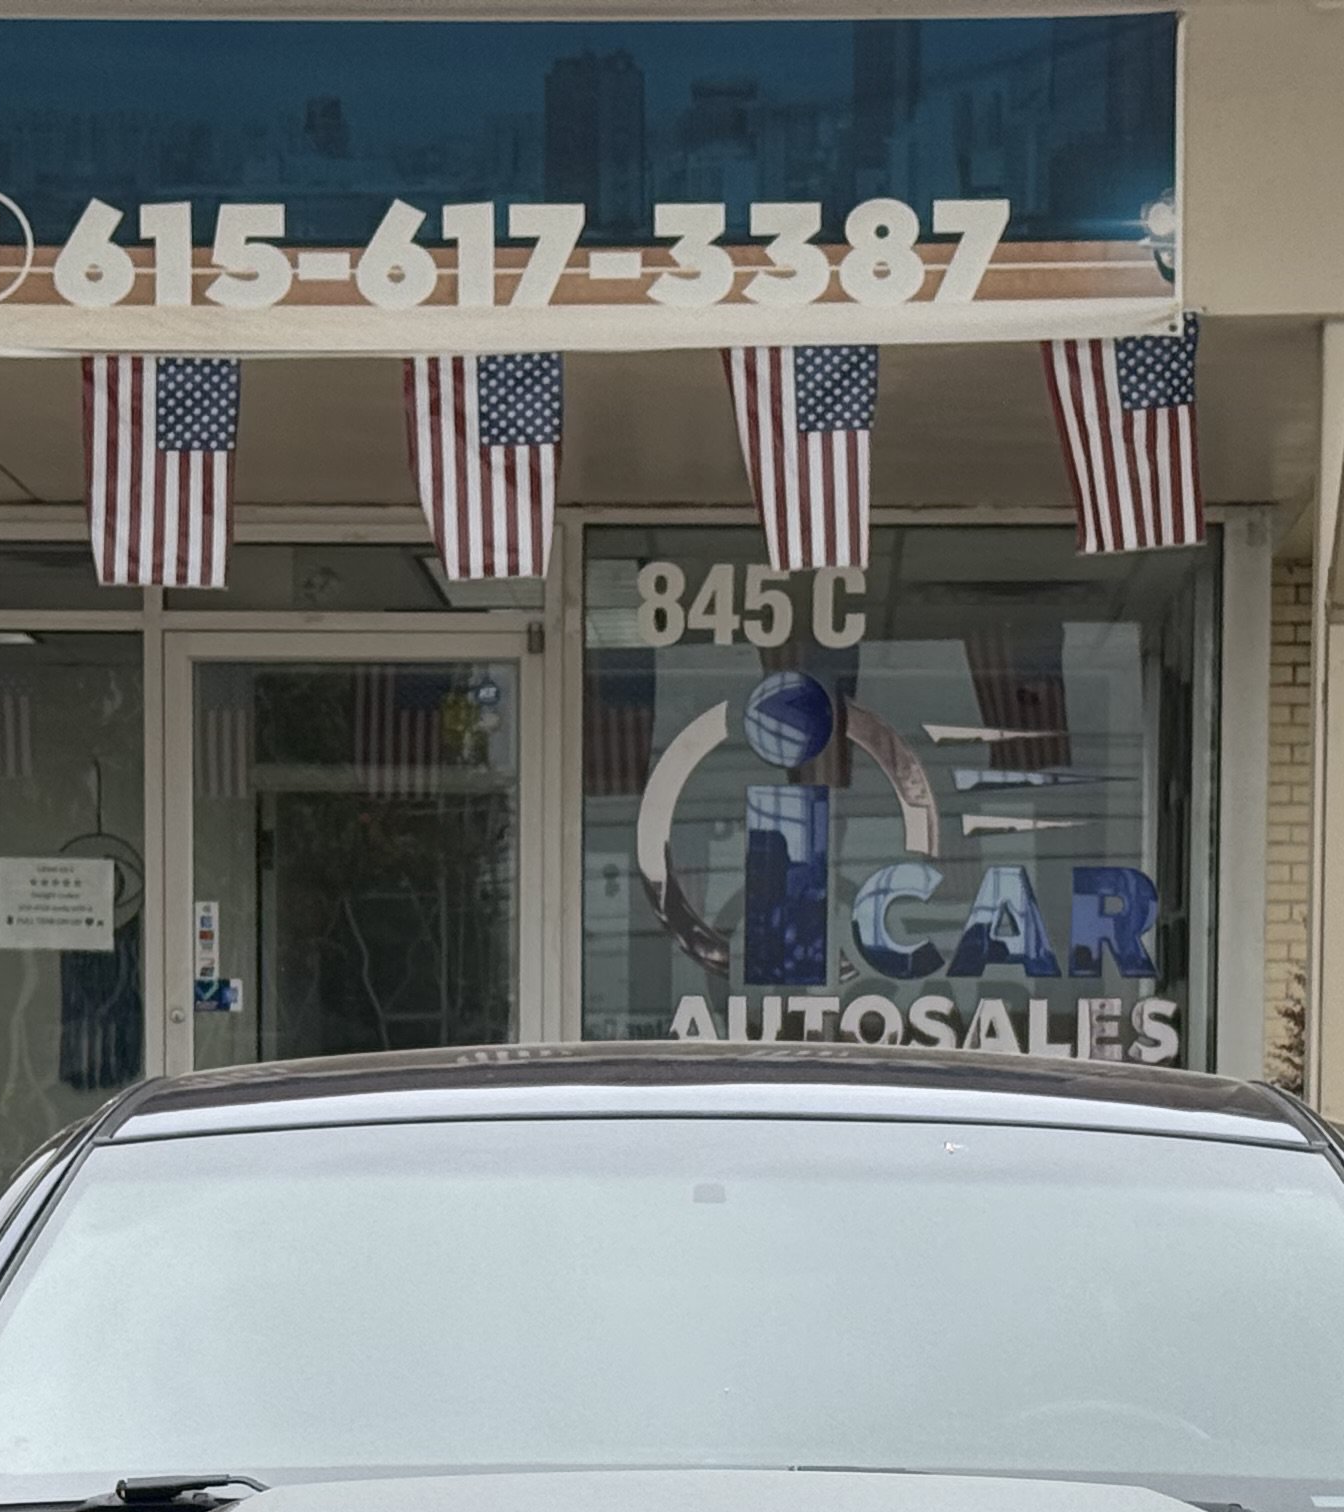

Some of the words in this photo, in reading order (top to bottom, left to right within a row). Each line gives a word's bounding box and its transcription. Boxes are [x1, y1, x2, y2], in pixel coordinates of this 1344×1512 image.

[54, 198, 1011, 308] 615-617-3387
[637, 562, 794, 647] 845
[668, 994, 1179, 1062] AUTOSALES
